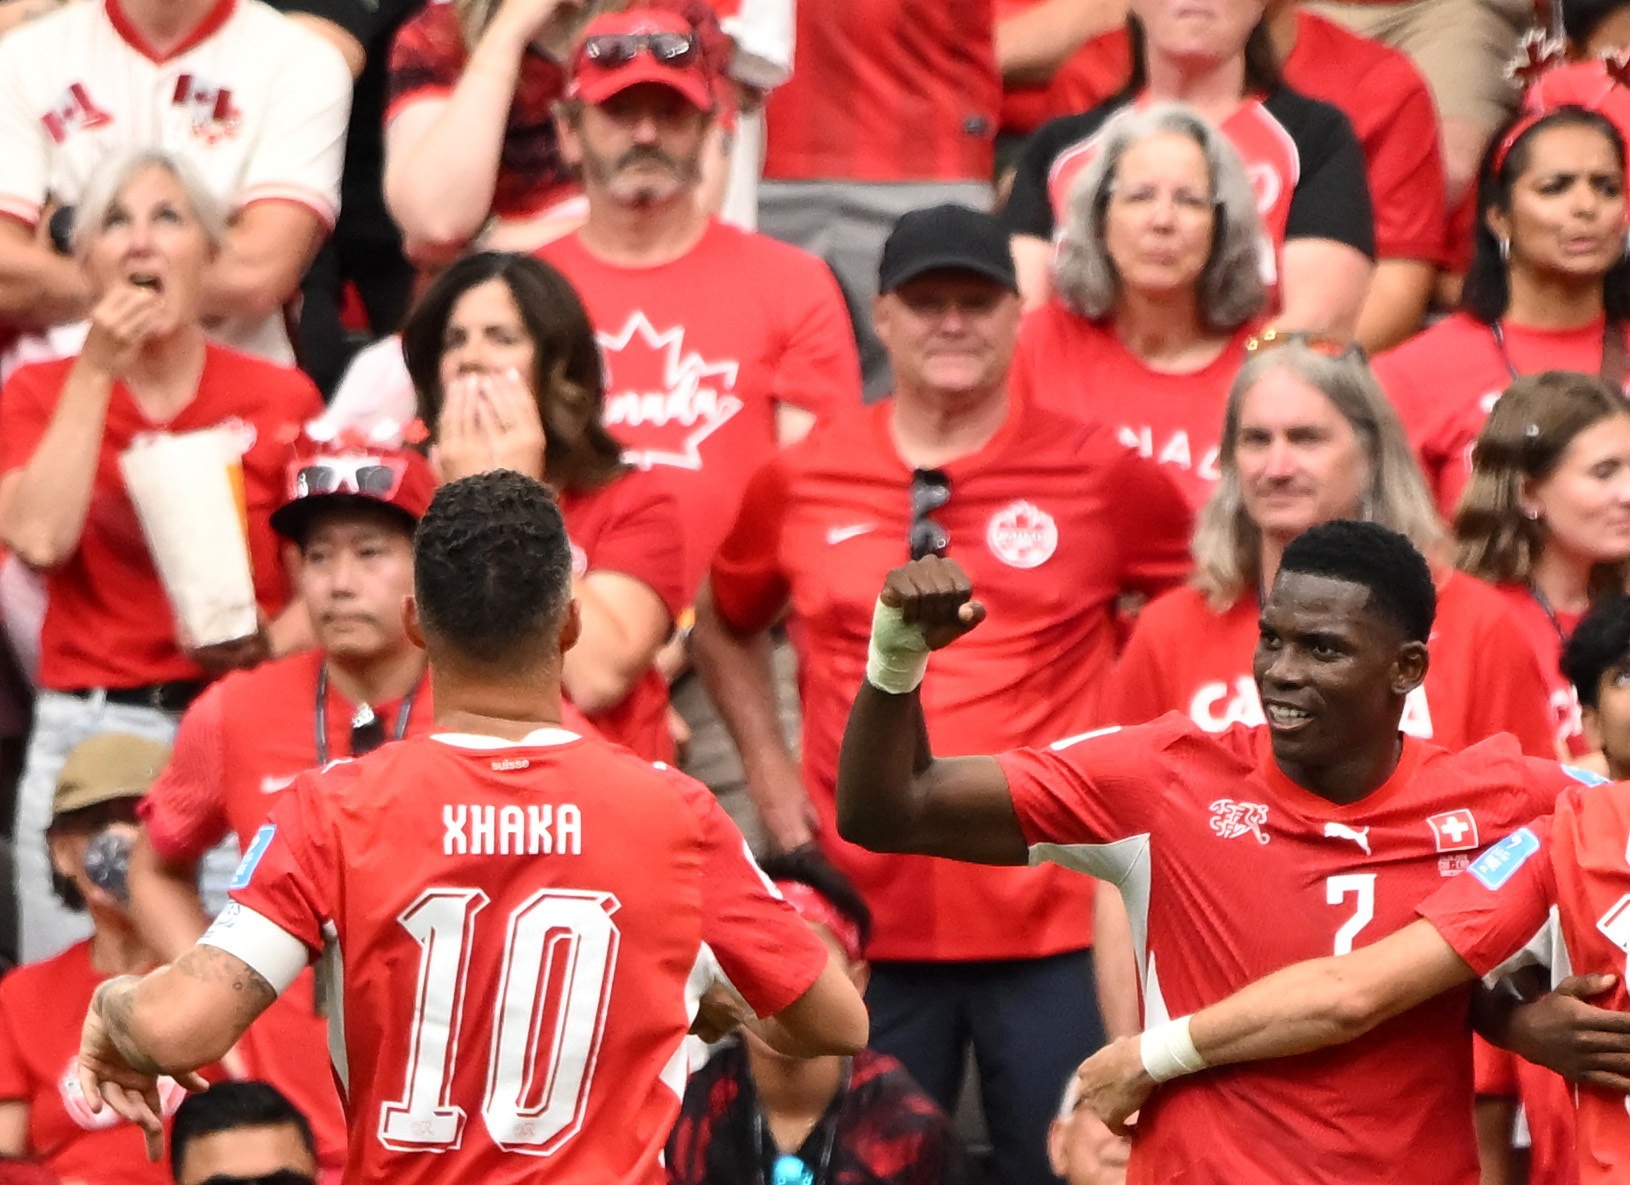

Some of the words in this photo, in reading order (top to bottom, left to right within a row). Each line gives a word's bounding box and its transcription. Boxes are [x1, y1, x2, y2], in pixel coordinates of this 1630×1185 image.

[491, 759, 530, 771] suisse
[443, 803, 582, 856] XHAKA
[1326, 873, 1378, 956] 7
[377, 887, 622, 1157] 10
